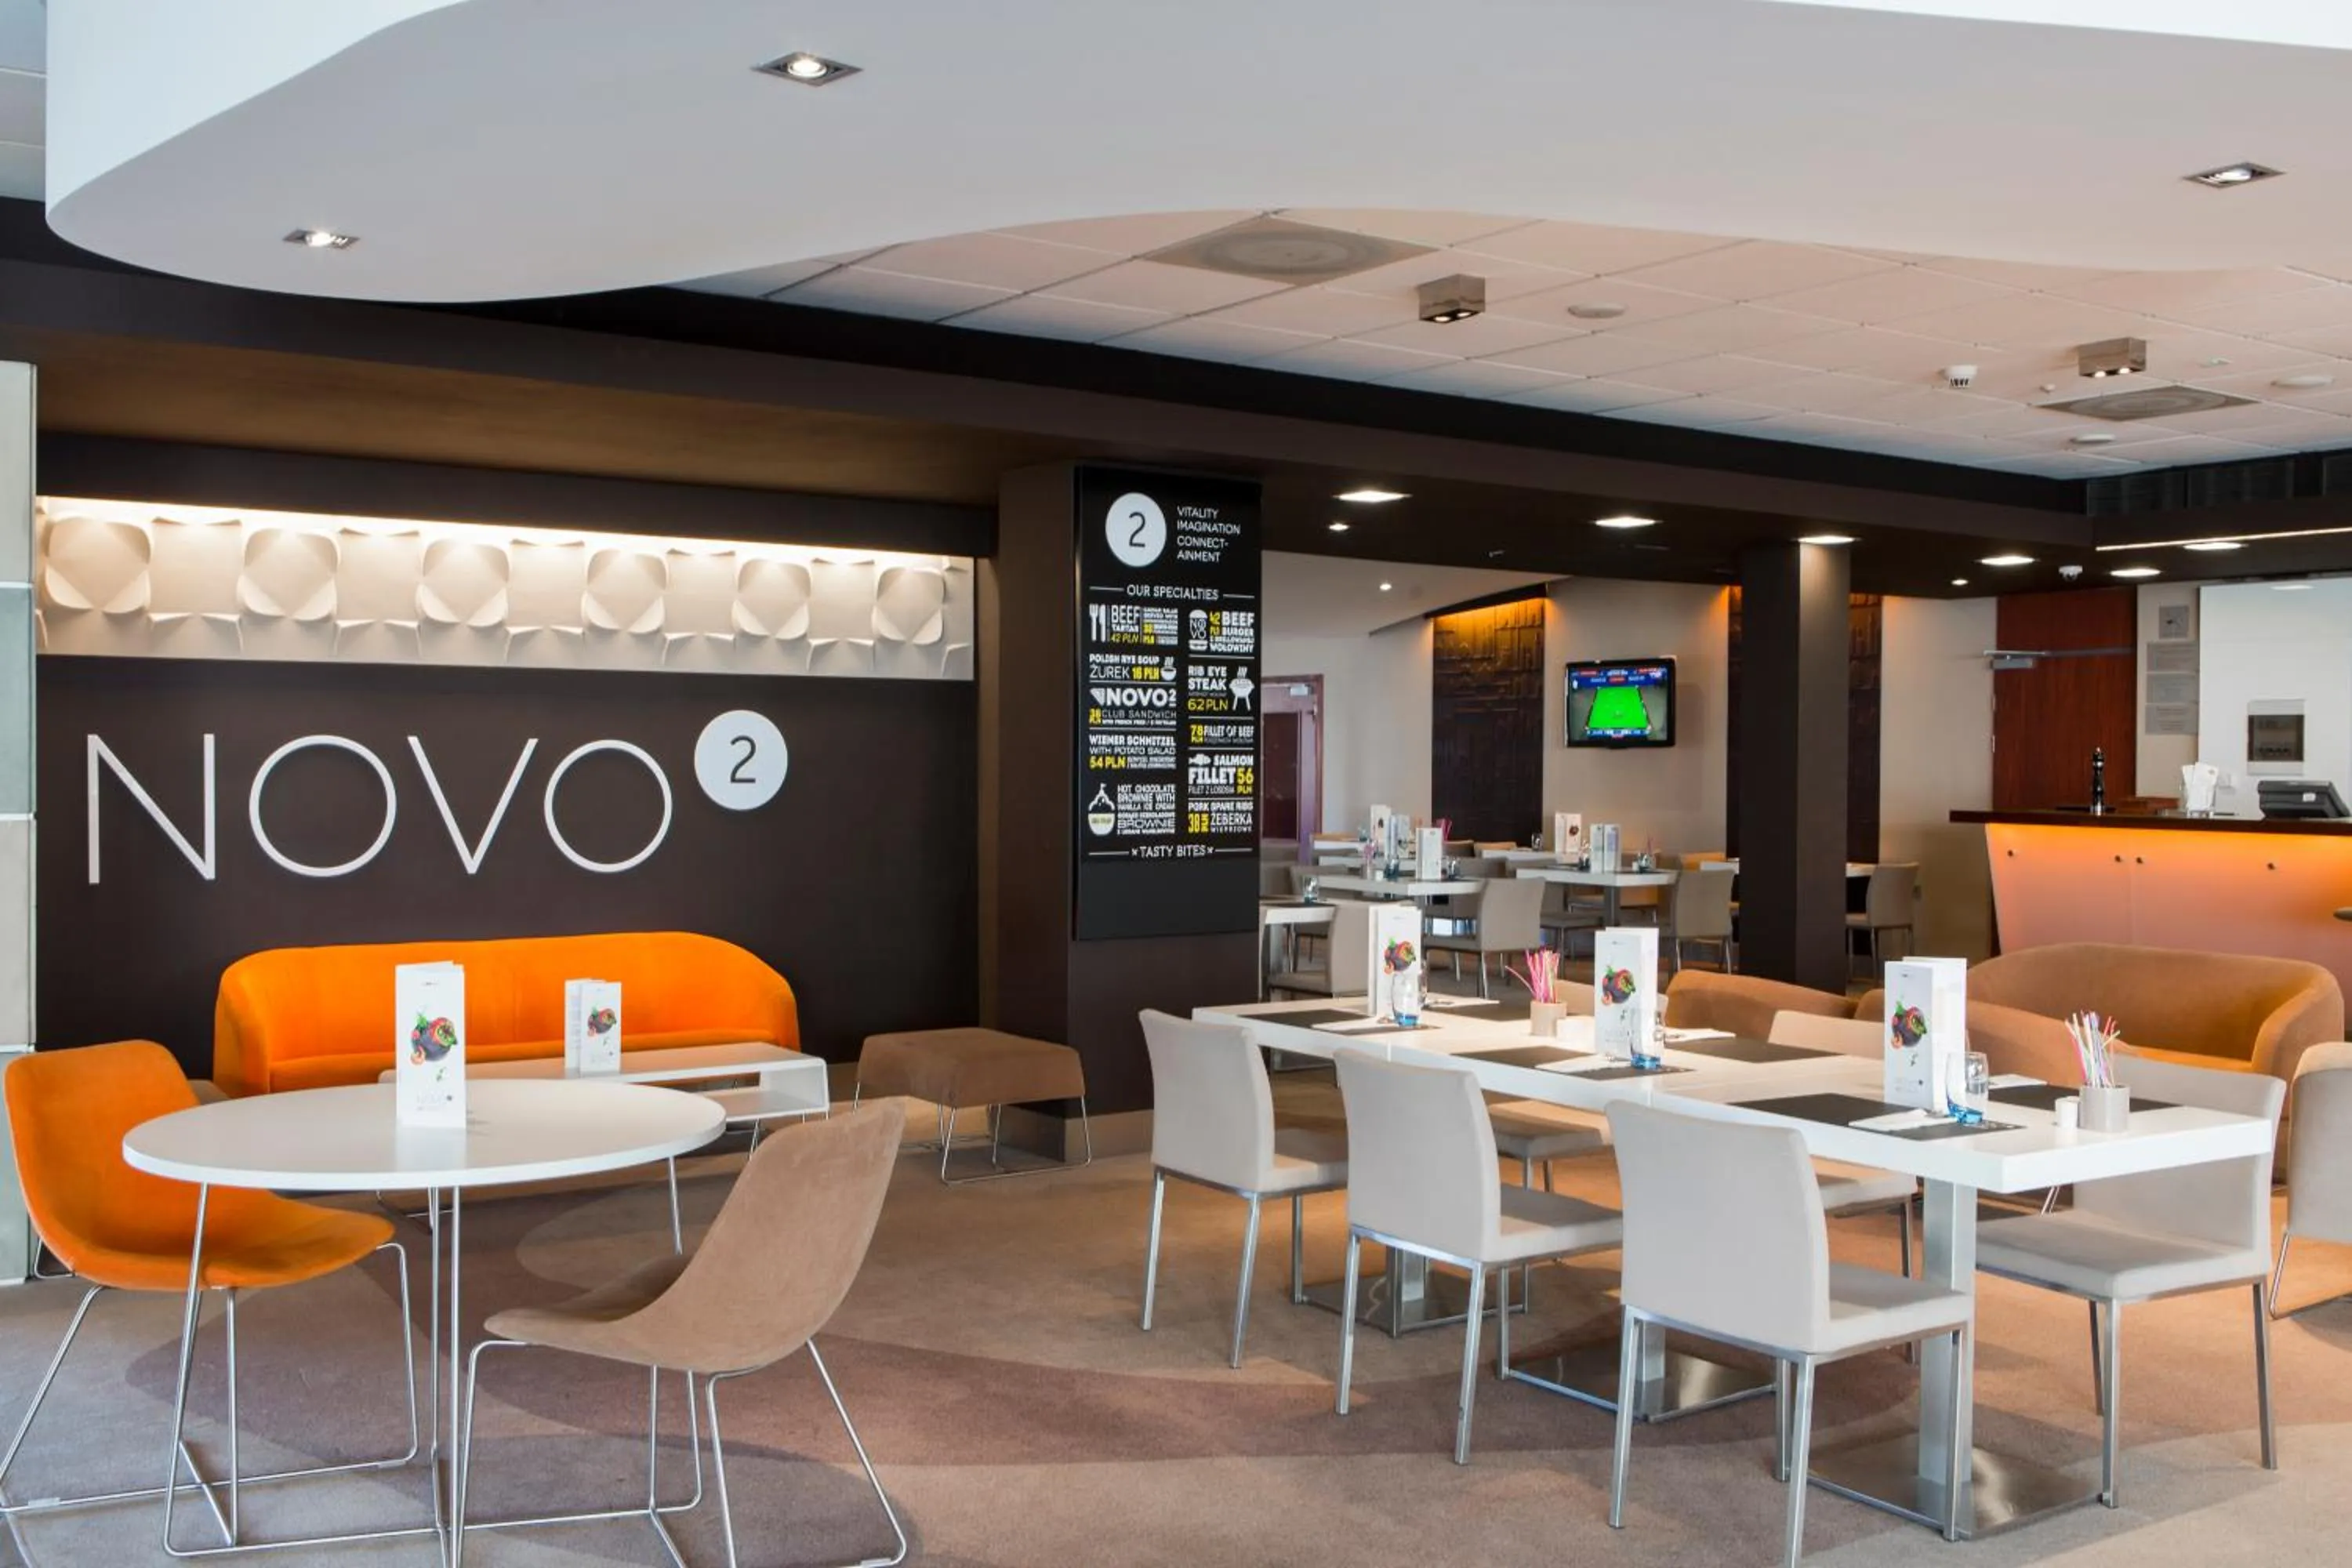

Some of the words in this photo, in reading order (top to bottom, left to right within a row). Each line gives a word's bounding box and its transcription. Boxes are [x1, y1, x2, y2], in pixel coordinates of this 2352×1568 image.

[1176, 506, 1218, 519] VITALITY
[1128, 511, 1145, 548] 2
[1176, 521, 1241, 535] IMAGINATION
[1176, 536, 1229, 549] CONNECT-
[1176, 550, 1221, 563] AINMENT
[1126, 584, 1150, 597] OUR
[1153, 586, 1219, 601] SPECIALTIES
[1111, 604, 1141, 624] BEEF
[1222, 611, 1254, 626] BEEF
[1222, 627, 1254, 637] BURGER
[1122, 633, 1139, 644] PLN
[1089, 653, 1120, 664] POLISH
[1121, 655, 1136, 664] RYE
[1138, 655, 1160, 665] SOUP
[1143, 666, 1160, 681] PLN
[1188, 666, 1205, 677] RIB
[1207, 666, 1227, 677] EYE
[1188, 677, 1227, 691] STEAK
[1188, 699, 1205, 711] 62
[1206, 699, 1229, 711] PLN
[1102, 709, 1125, 718] CLUB
[1128, 710, 1177, 719] SANDWICH
[1190, 724, 1203, 736] 78
[1089, 735, 1124, 746] WIENER
[1127, 735, 1176, 746] SCHNITZEL
[1089, 746, 1111, 755] WITH
[1089, 755, 1104, 769] 54
[1105, 755, 1126, 768] PLN
[1213, 754, 1254, 766] SALMON
[1188, 766, 1236, 785] FILLET
[1236, 767, 1254, 785] 56
[1117, 784, 1132, 793] HOT
[1134, 784, 1176, 793] CHOCOLATE
[1236, 785, 1253, 794] PLN
[1117, 793, 1153, 803] BROWNIE
[1155, 793, 1175, 802] WITH
[87, 733, 673, 884] NOVO
[729, 735, 757, 784] 2
[1188, 802, 1209, 812] PORK
[1210, 801, 1235, 812] SPARE
[1117, 818, 1176, 829] BROWNIE
[1139, 845, 1174, 858] TASTY
[1176, 844, 1205, 858] BITES
